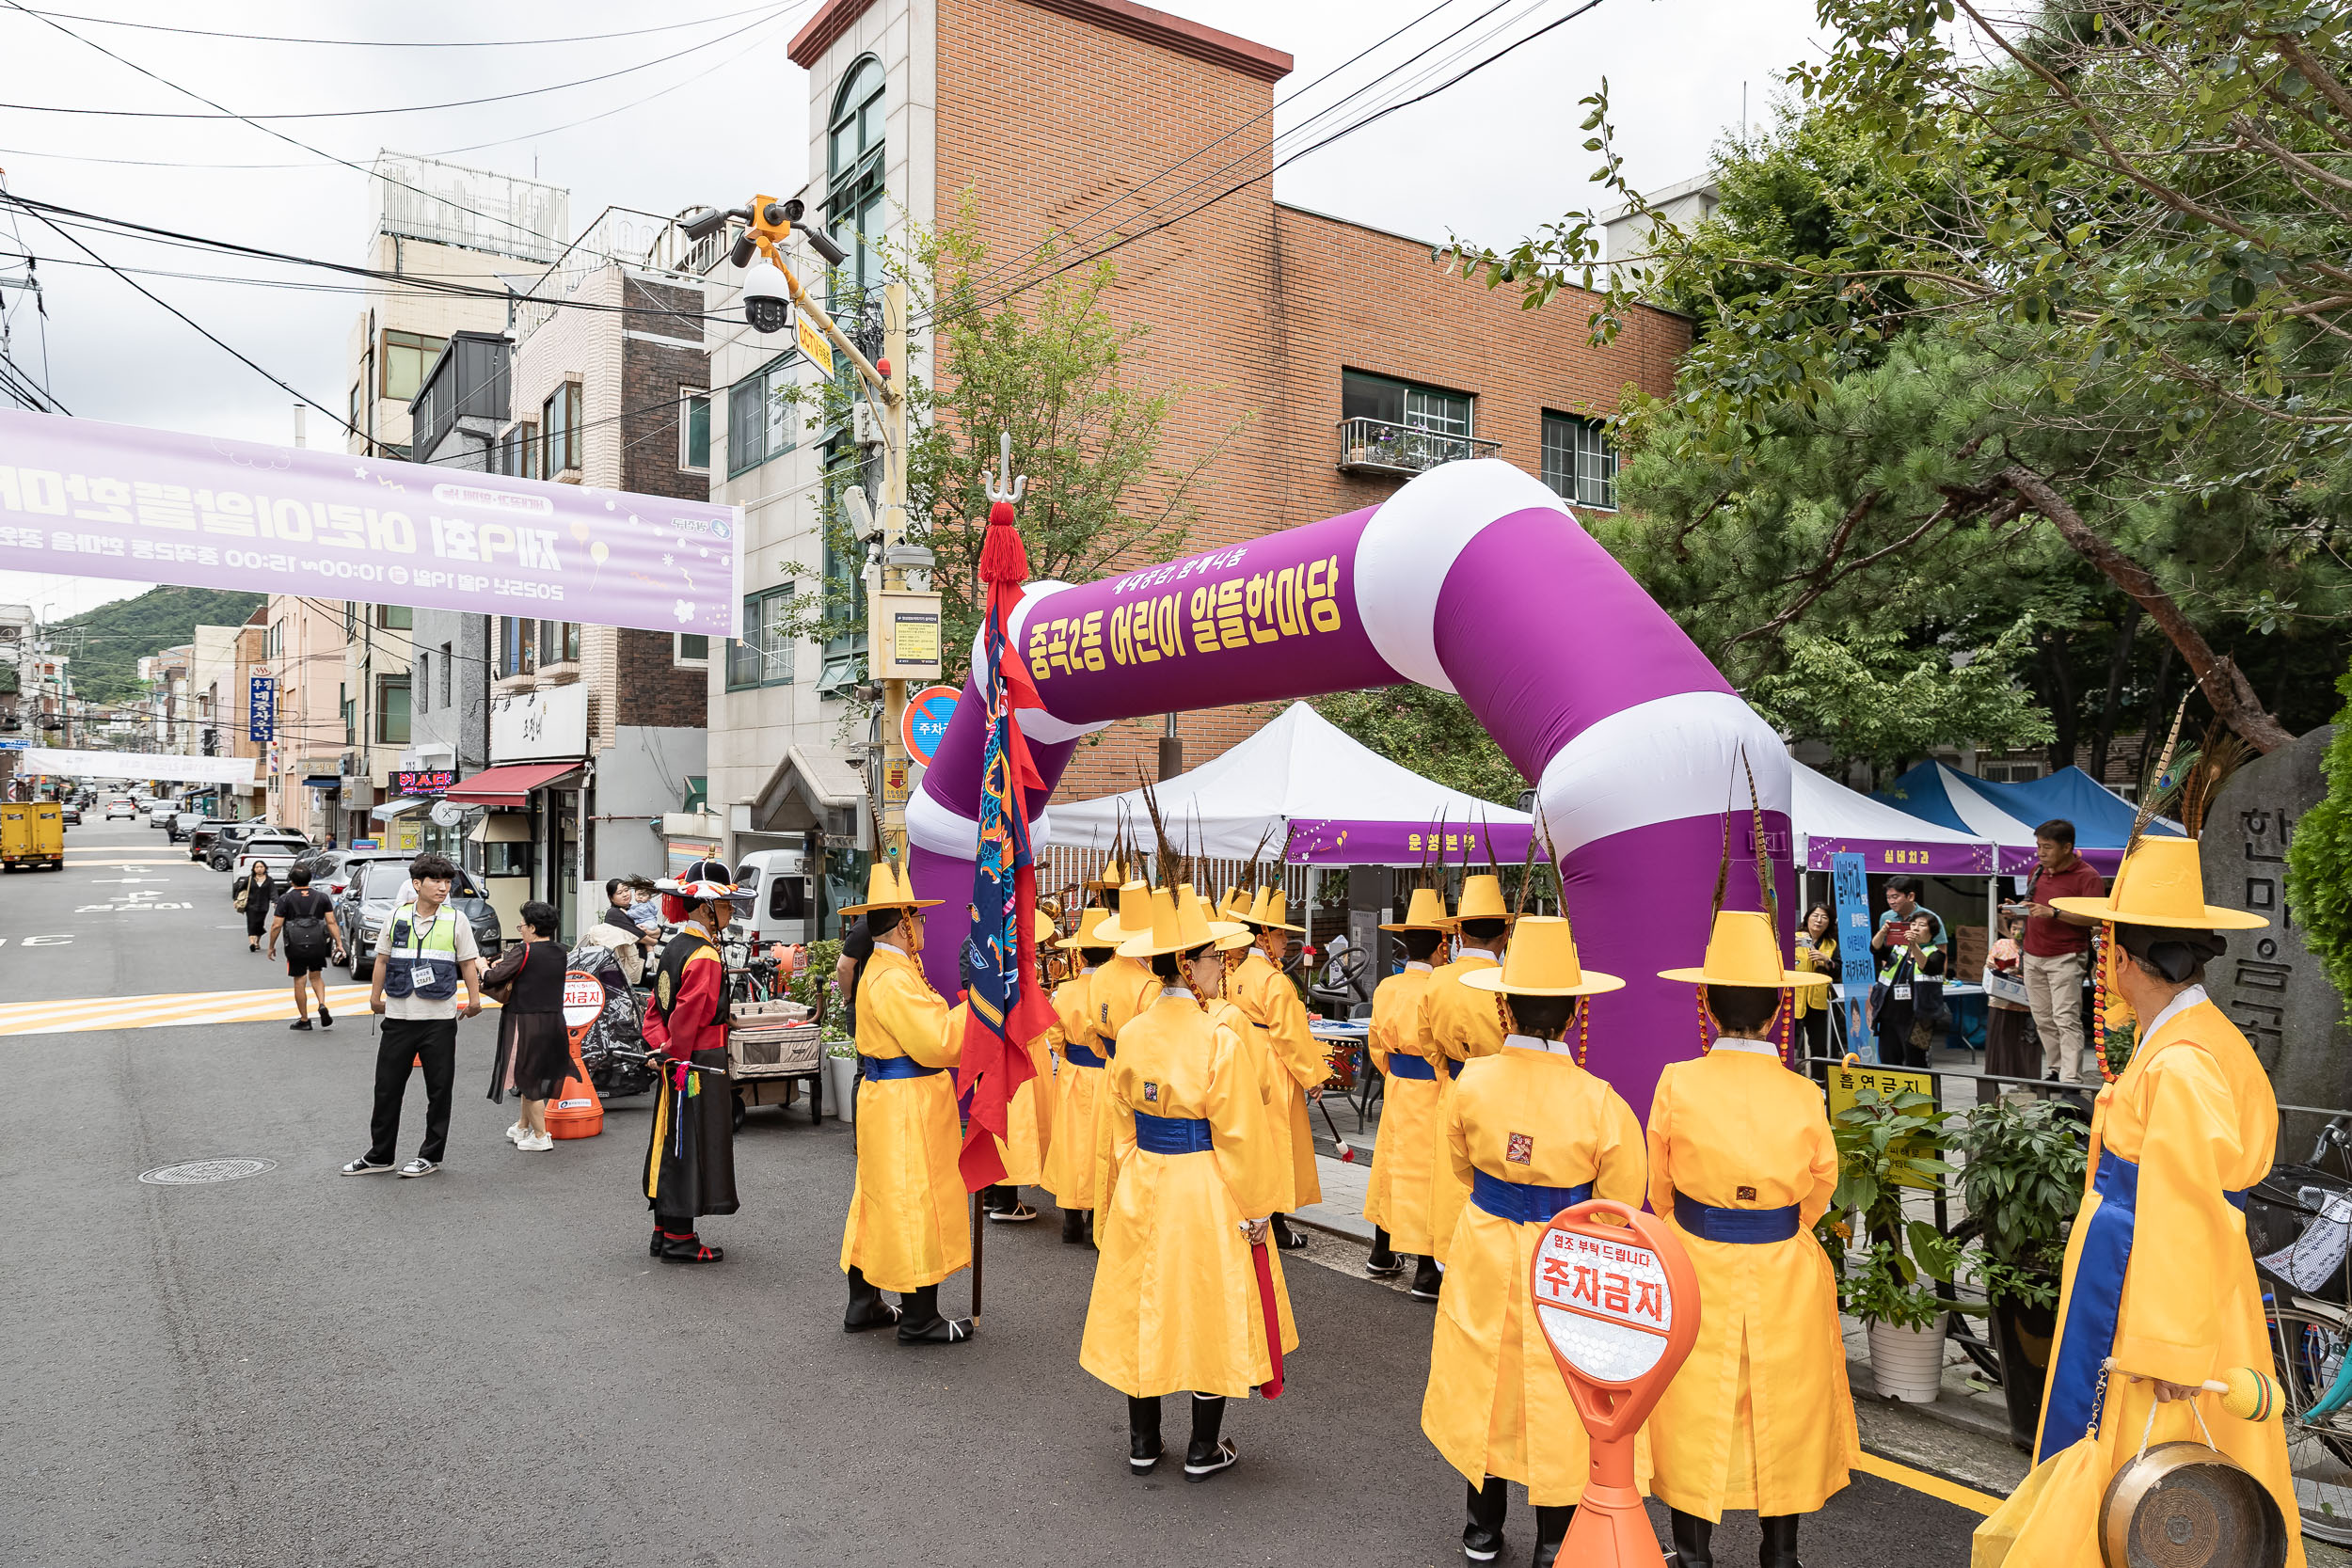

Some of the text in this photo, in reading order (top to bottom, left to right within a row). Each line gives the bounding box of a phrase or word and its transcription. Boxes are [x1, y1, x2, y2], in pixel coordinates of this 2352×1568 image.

[800, 324, 818, 357] CCTV
[1028, 554, 1342, 680] 중곡2동 어린이 알뜰한마당
[1847, 935, 1867, 953] 어린이
[1554, 1234, 1650, 1267] 협조 부탁 드립니다
[1543, 1257, 1662, 1323] 주차금지
